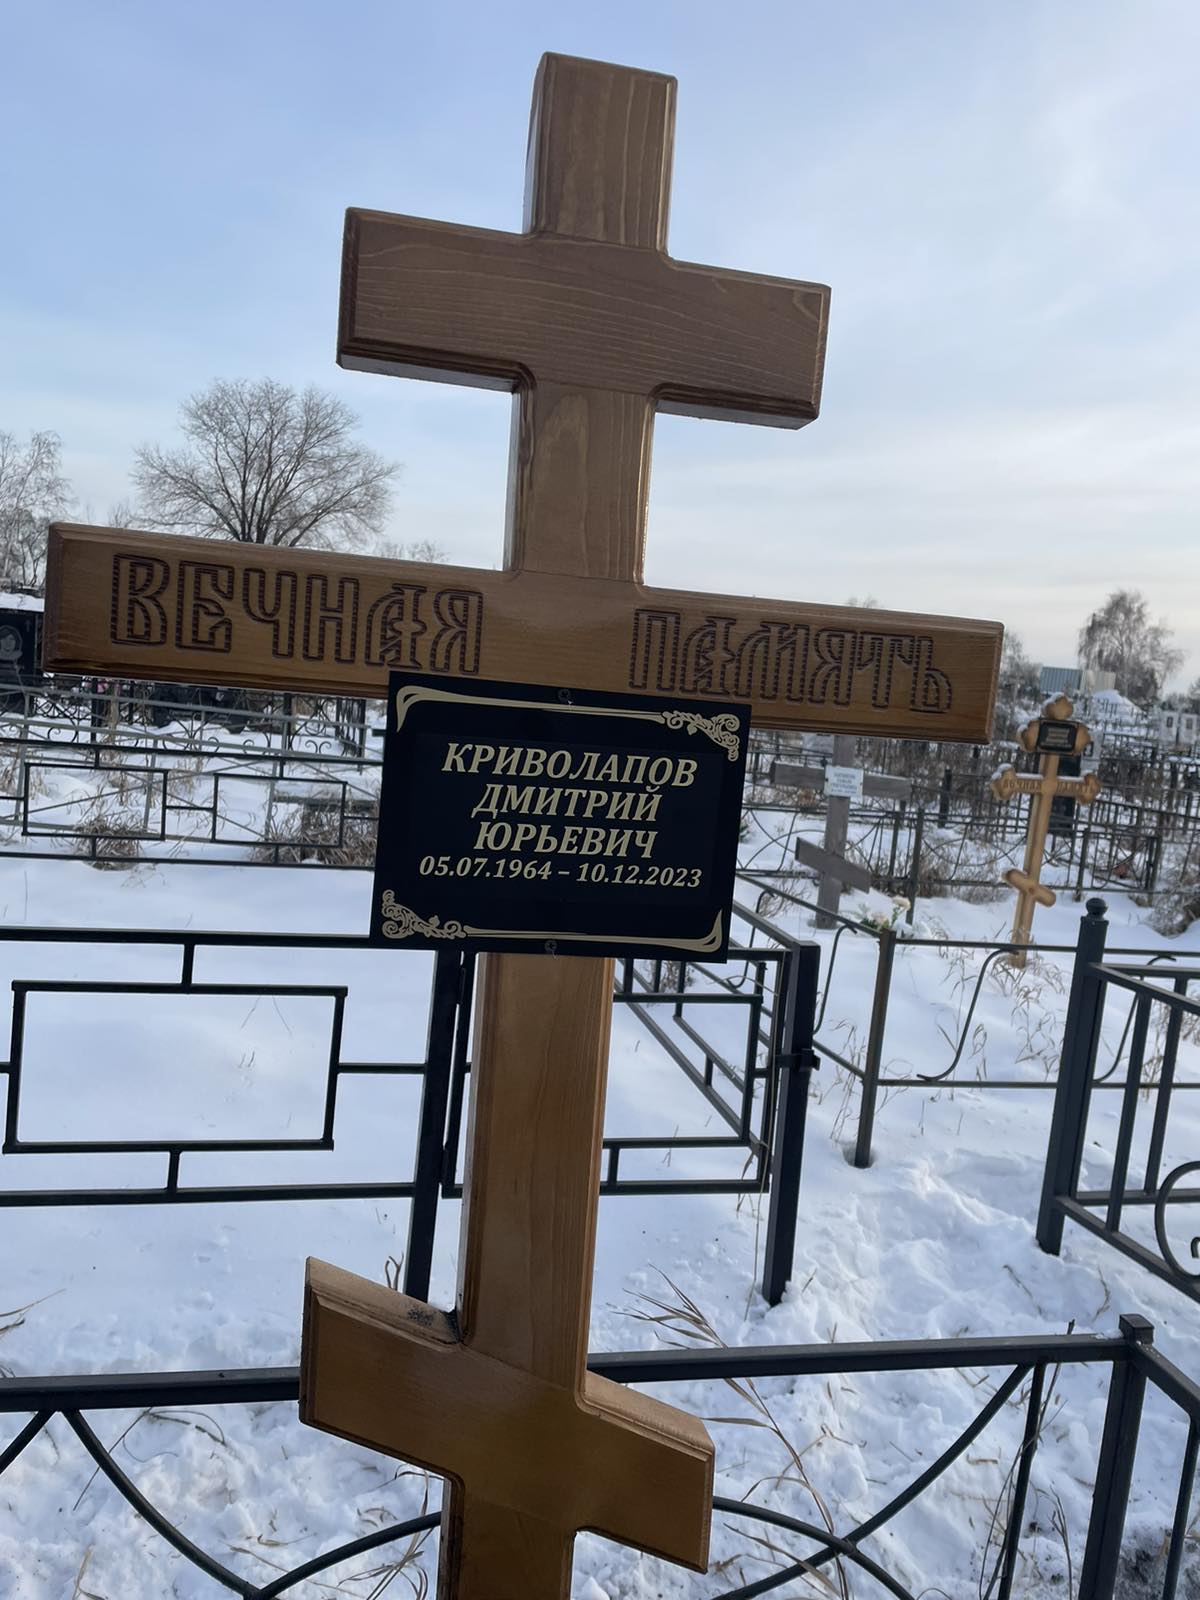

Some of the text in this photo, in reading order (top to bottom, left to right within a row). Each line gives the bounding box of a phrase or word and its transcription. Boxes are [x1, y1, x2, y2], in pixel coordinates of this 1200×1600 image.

[110, 553, 952, 714] ВЕЧНАЯ ПАМЯТЬ
[441, 742, 698, 787] КРИВОЛАПОВ
[470, 783, 663, 822] ДМИТРИЙ
[473, 821, 659, 859] ЮРЬЕВИЧ
[419, 855, 552, 880] 05.07.1964
[576, 862, 703, 888] 10.12.2023
